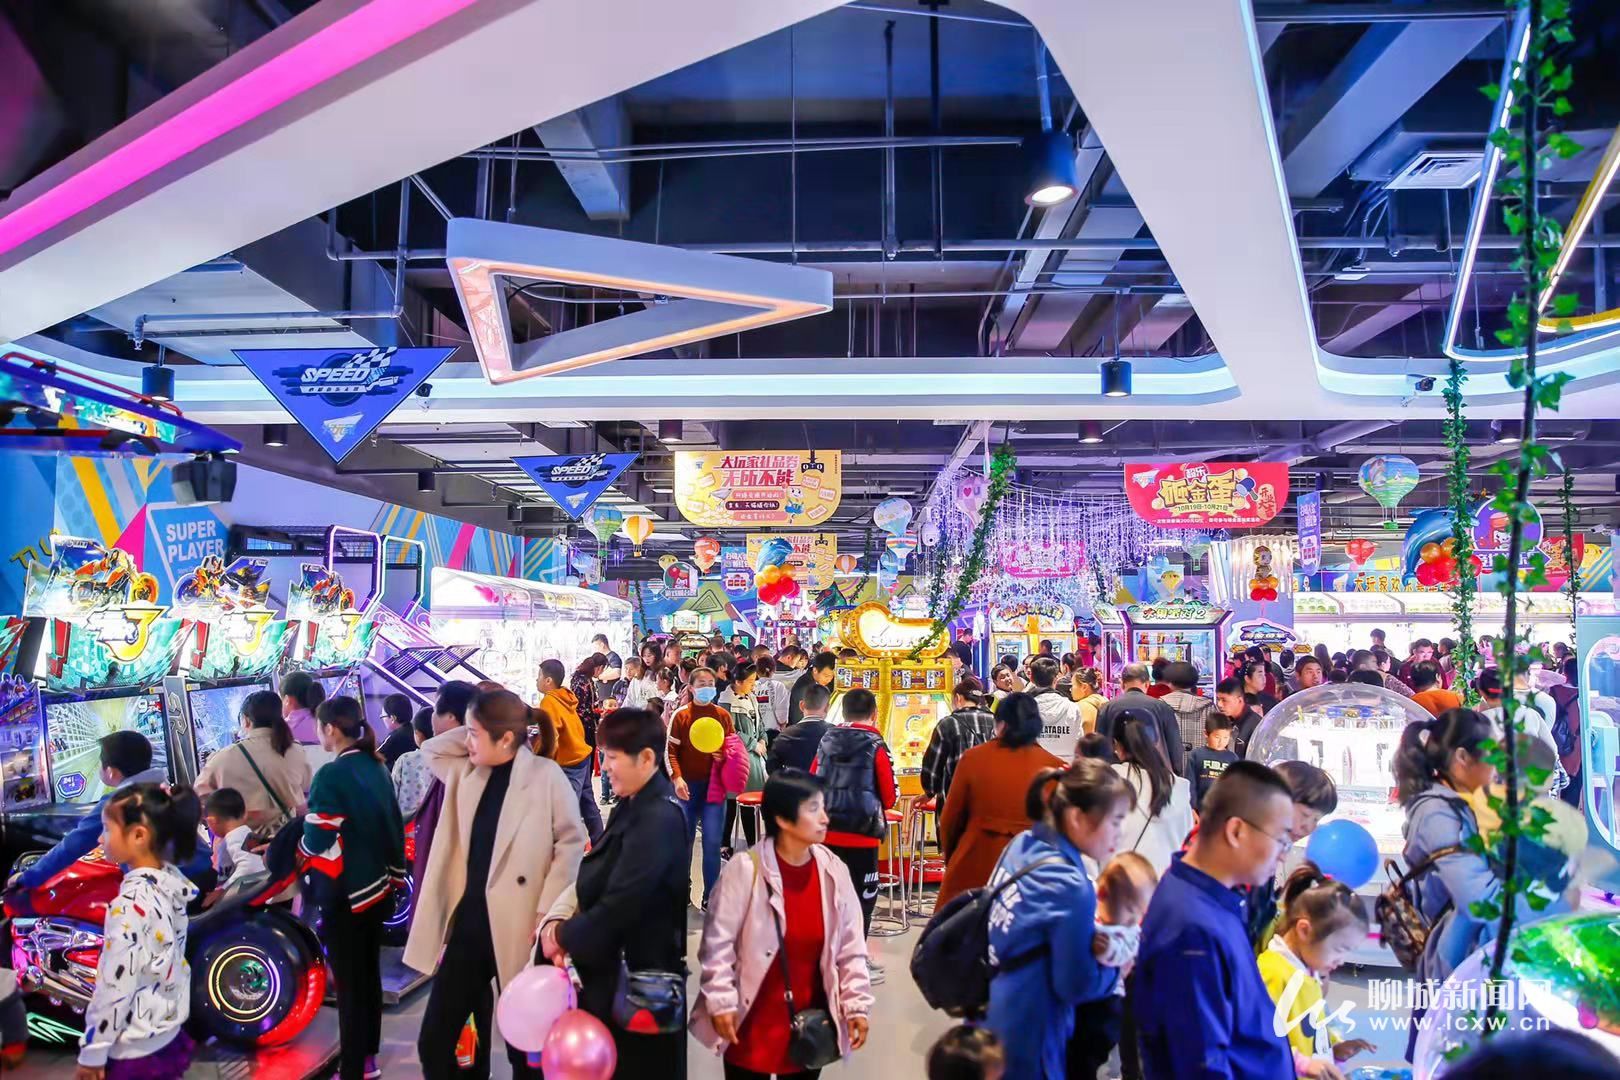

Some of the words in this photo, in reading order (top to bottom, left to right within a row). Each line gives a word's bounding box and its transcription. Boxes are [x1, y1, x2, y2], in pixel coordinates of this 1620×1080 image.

[300, 367, 371, 382] SPEED
[551, 466, 591, 475] SPEED
[720, 455, 800, 469] 大玩家礼品券
[721, 469, 796, 488] 无所不能
[1159, 469, 1236, 508] 砸金蛋
[166, 520, 216, 542] SUPER
[167, 538, 225, 563] PLAYER
[1195, 608, 1206, 620] 2
